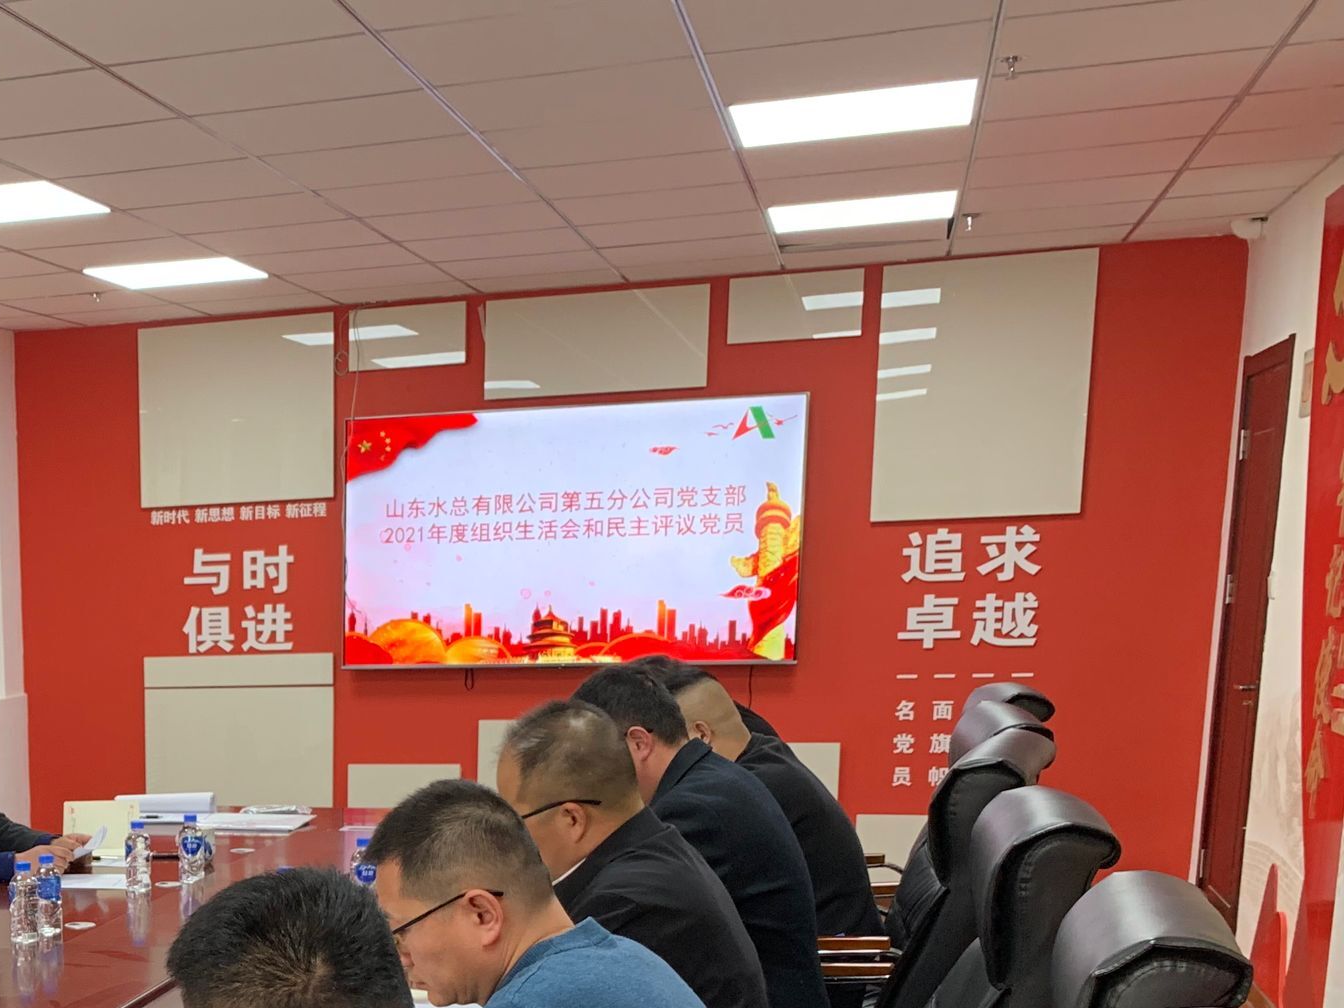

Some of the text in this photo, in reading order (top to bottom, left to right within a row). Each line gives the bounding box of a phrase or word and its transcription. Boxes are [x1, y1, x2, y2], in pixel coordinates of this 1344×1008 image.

[150, 502, 327, 526] 新时代 新思想 新目标 新征程
[386, 484, 747, 519] 山东水总有限公司第五分公司党支部
[384, 513, 745, 545] 2021年度组织生活会和民主评议党员
[901, 524, 1042, 583] 追求
[183, 544, 295, 595] 与时
[182, 603, 294, 654] 俱进
[897, 592, 1039, 649] 卓越
